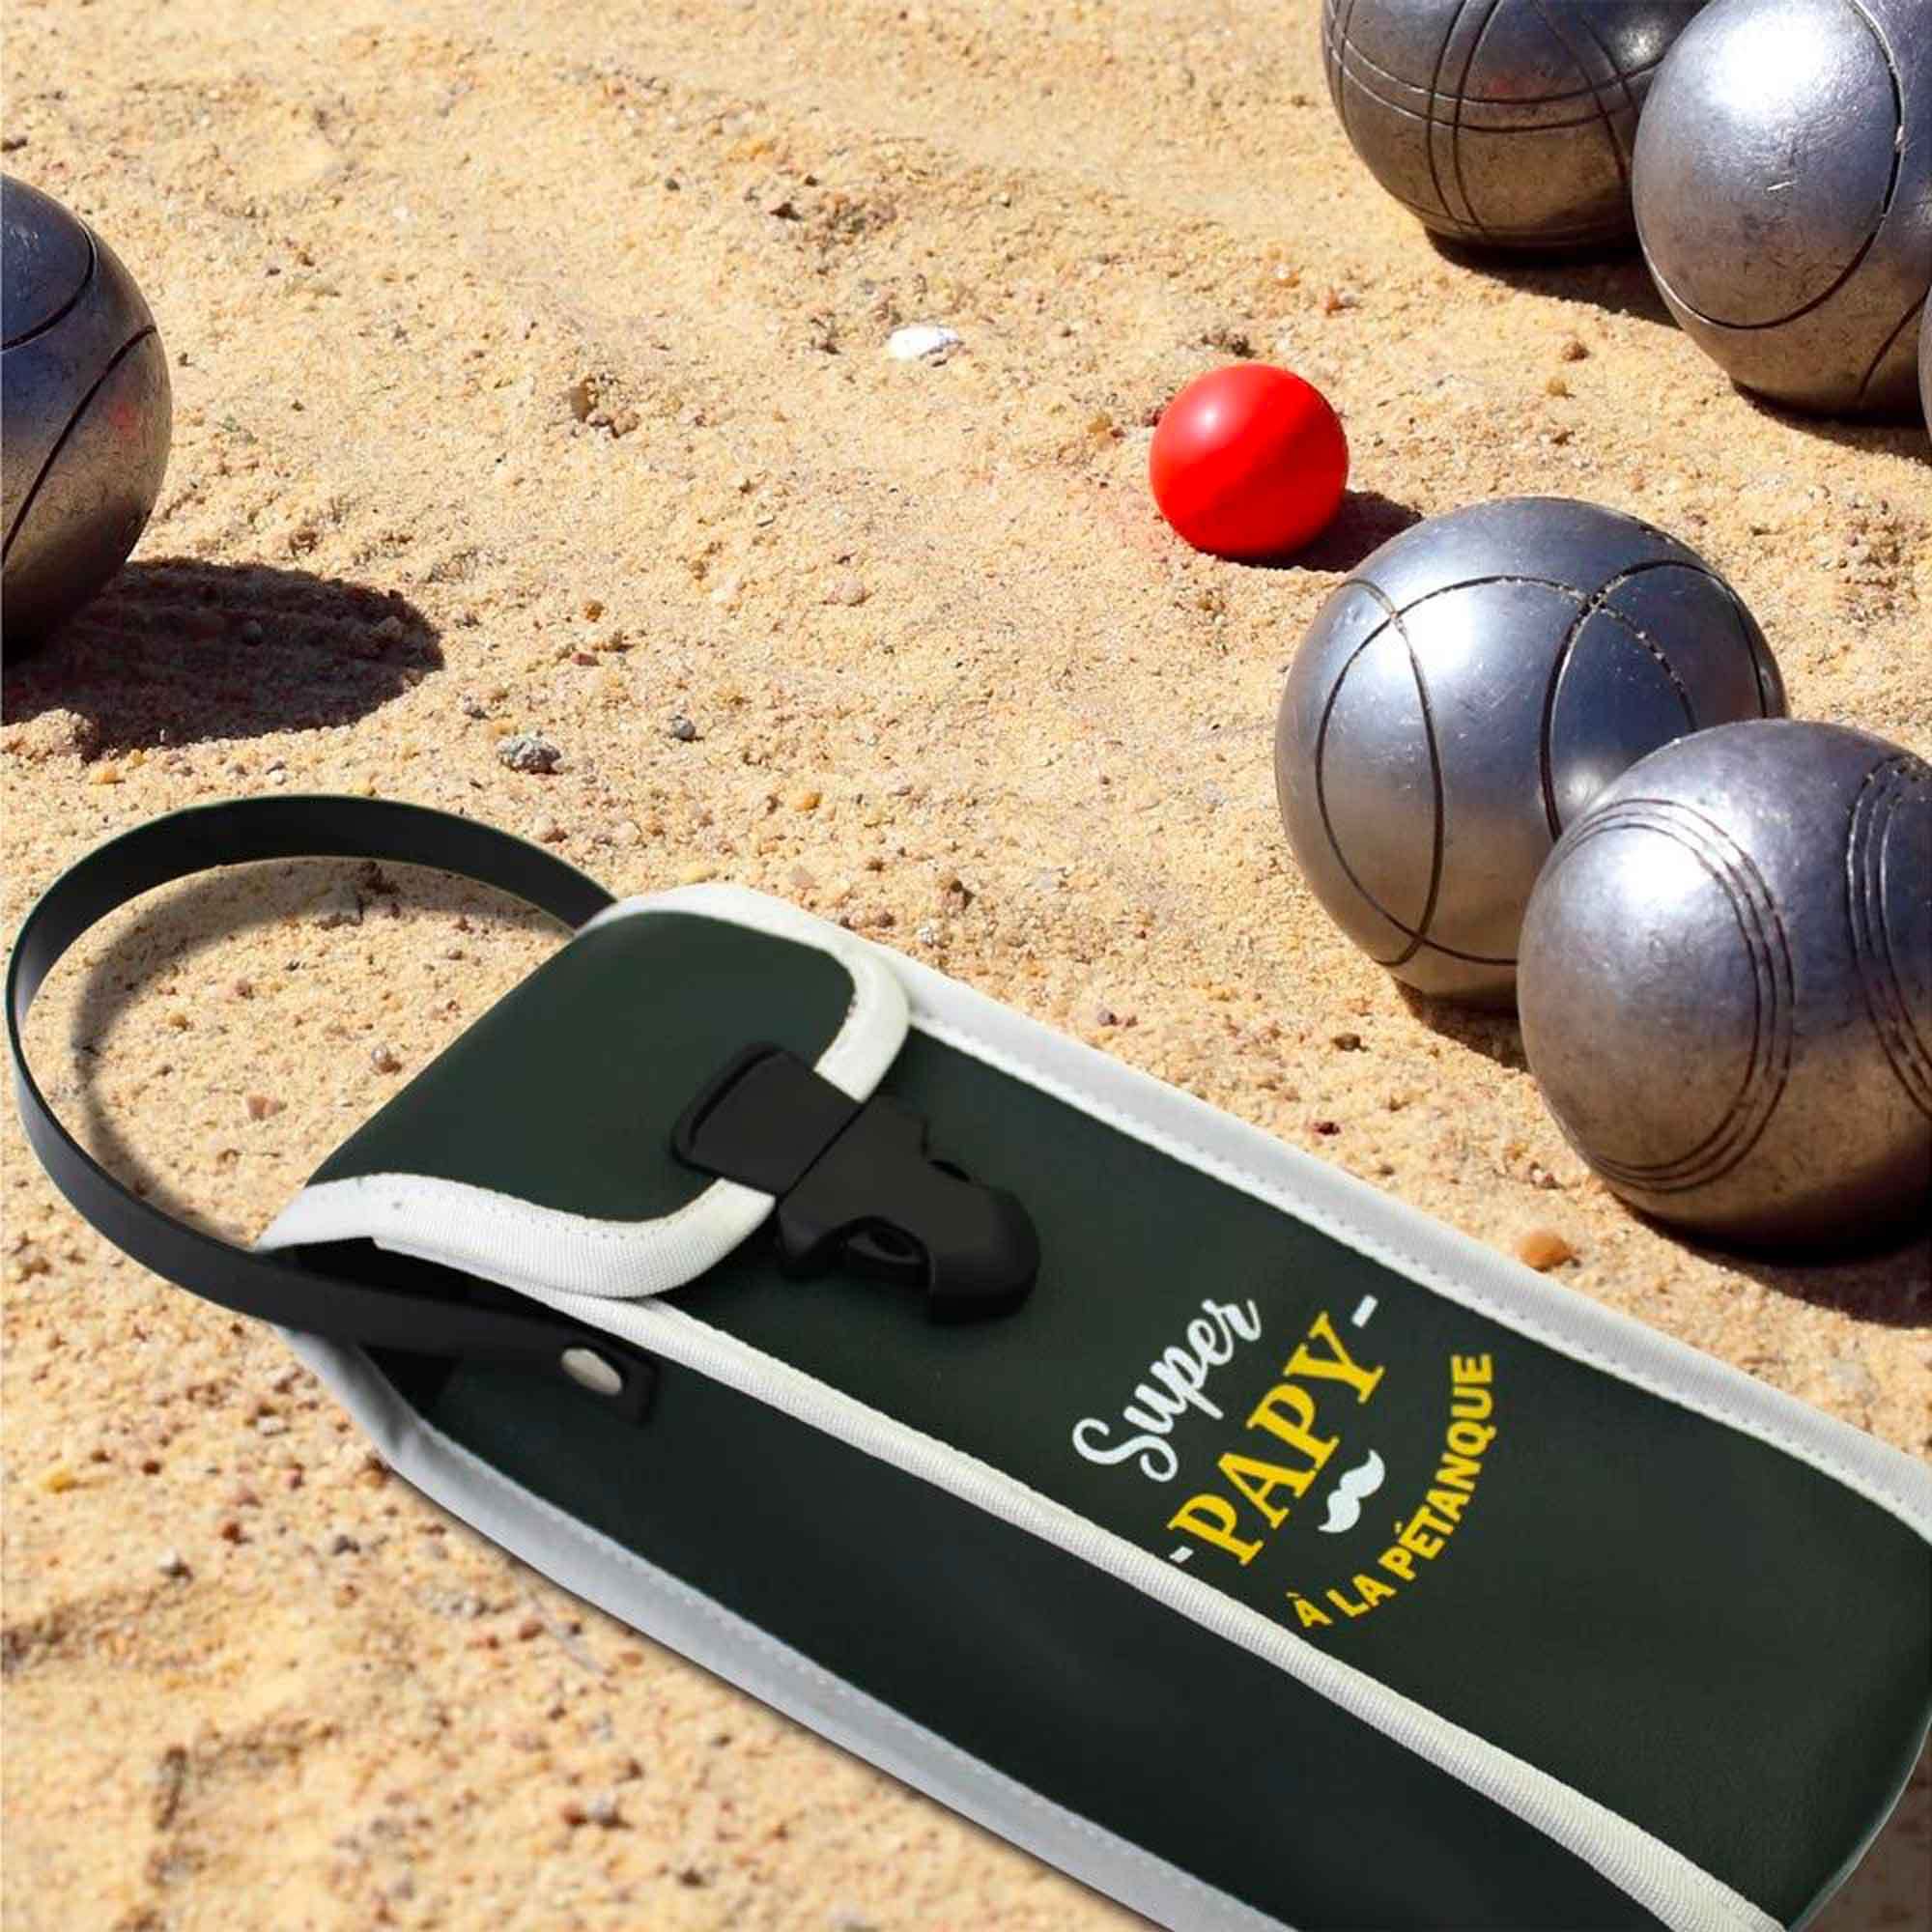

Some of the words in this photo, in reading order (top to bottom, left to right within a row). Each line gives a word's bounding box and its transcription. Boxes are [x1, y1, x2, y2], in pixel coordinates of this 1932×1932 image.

[1071, 1299, 1262, 1482] Super
[1167, 1311, 1384, 1566] PAPY
[1286, 1592, 1333, 1628] À
[1326, 1573, 1396, 1617] LA
[1378, 1353, 1496, 1580] PÉTANQUE
